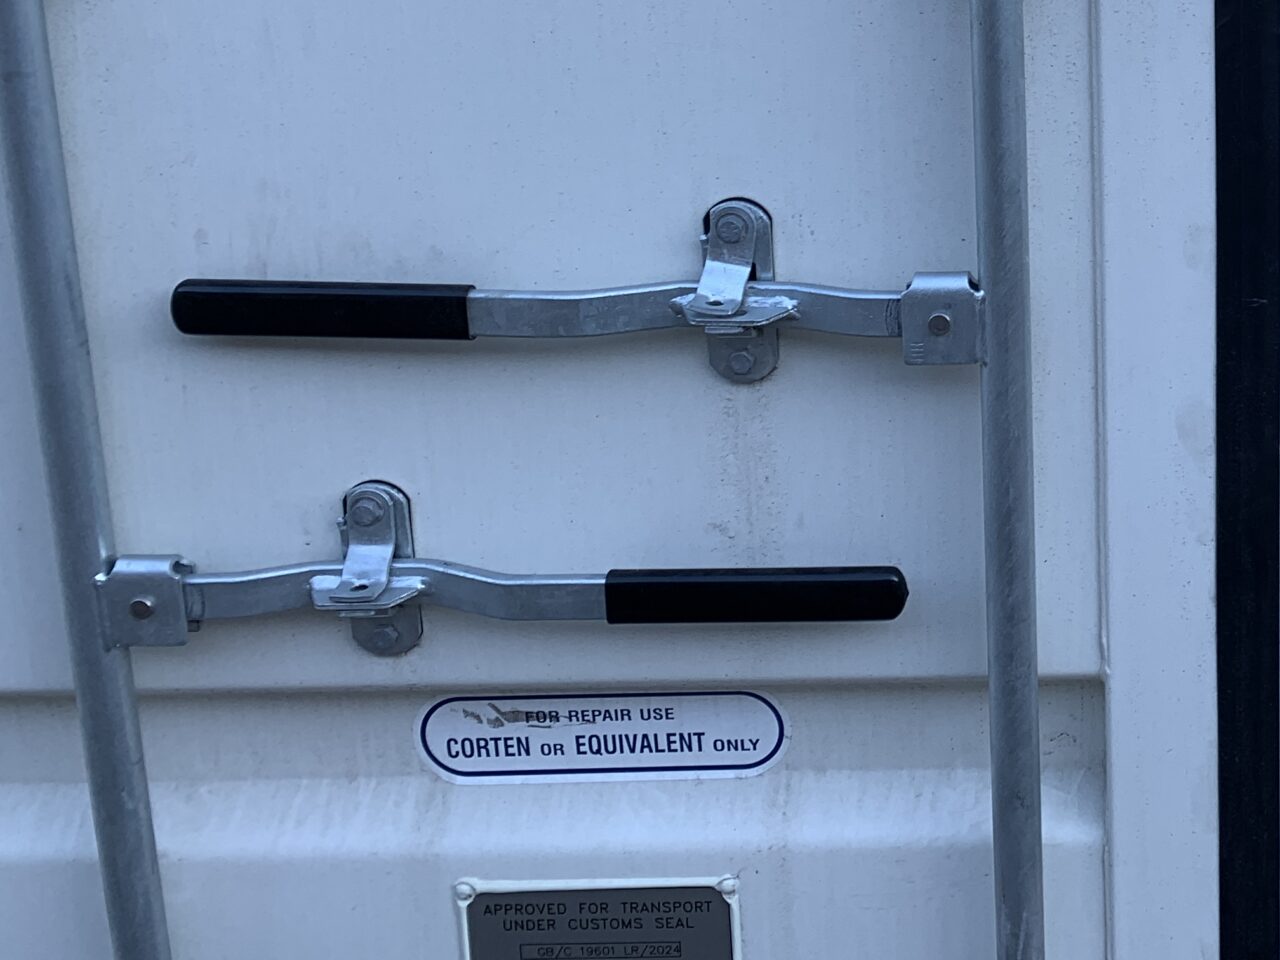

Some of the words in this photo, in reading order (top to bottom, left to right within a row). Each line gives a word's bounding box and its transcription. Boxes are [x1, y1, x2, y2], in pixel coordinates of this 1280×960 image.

[525, 710, 561, 724] FOR
[568, 708, 633, 723] REPAIR
[640, 707, 675, 721] USE
[446, 735, 532, 759] CORTEN
[540, 742, 565, 757] OR
[574, 731, 706, 757] EQUIVALENT
[713, 738, 761, 753] ONLY
[483, 903, 567, 916] APPROVED
[579, 902, 609, 914] FOR
[622, 900, 713, 914] TRANSPORT
[502, 918, 556, 931] UNDER
[567, 917, 644, 931] CUSTOMS
[655, 916, 695, 929] SEAL
